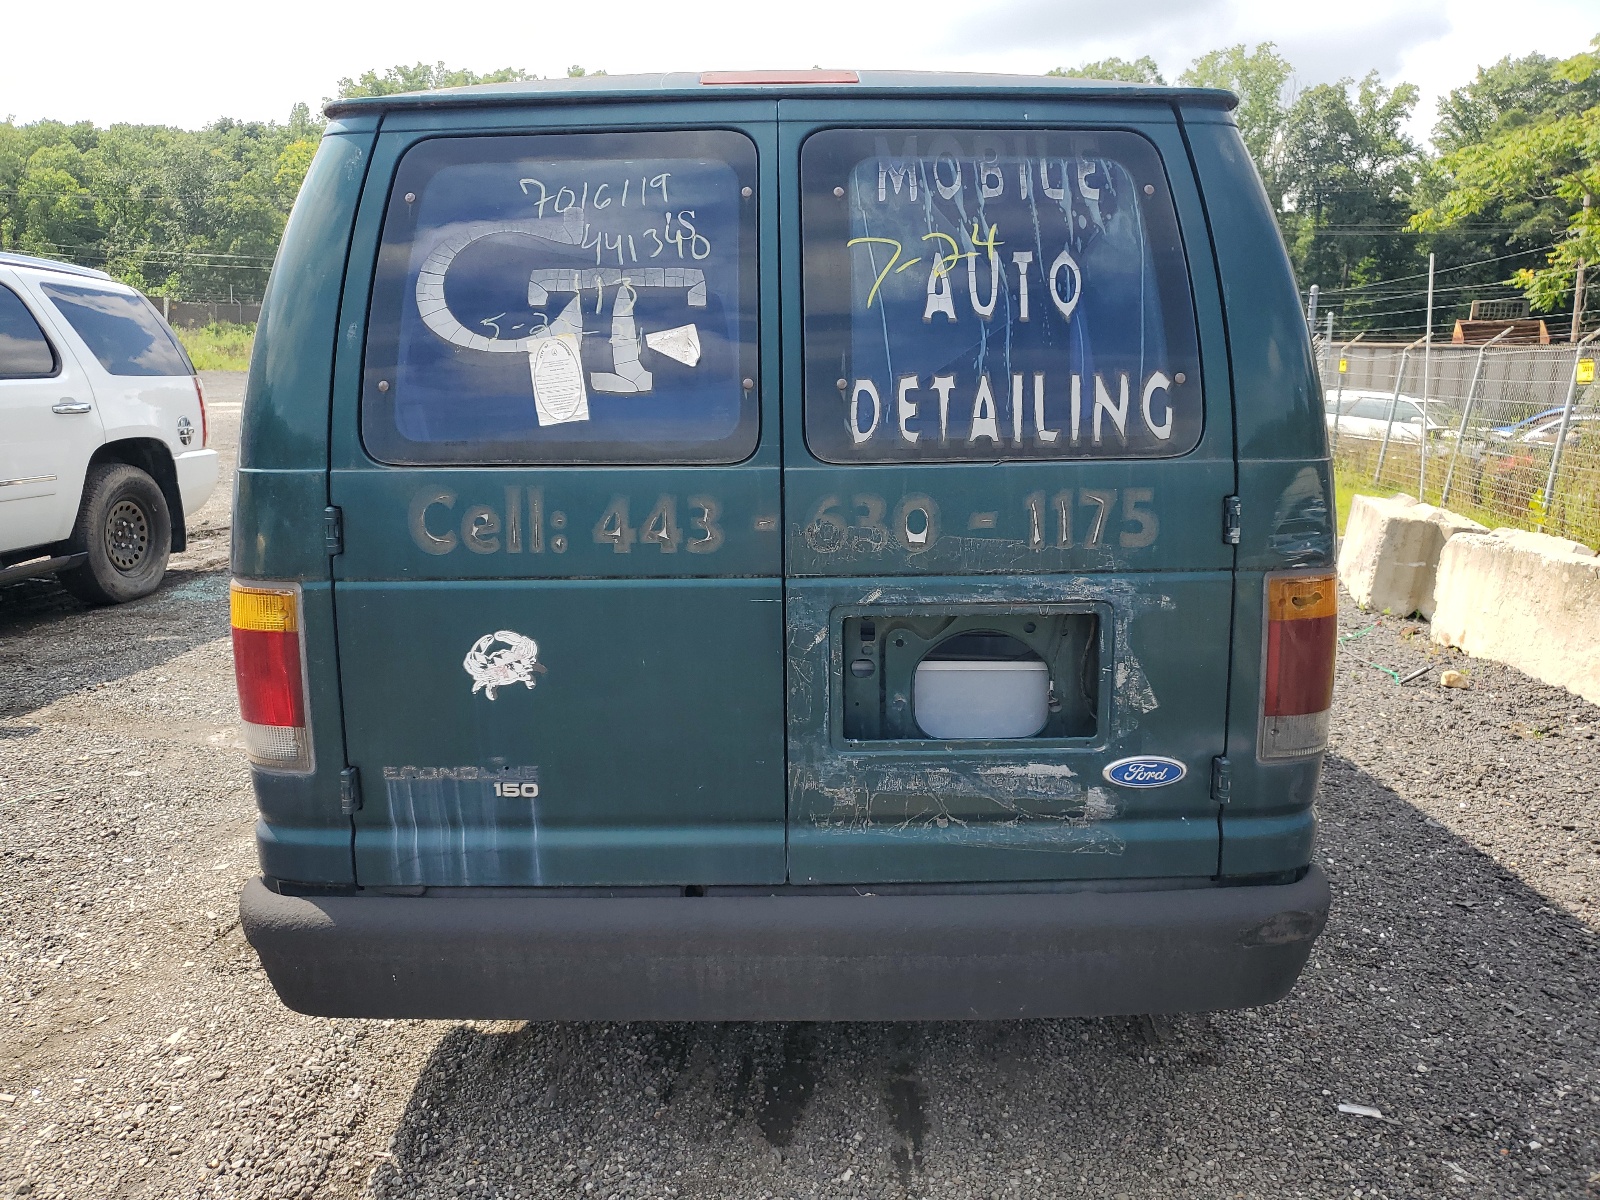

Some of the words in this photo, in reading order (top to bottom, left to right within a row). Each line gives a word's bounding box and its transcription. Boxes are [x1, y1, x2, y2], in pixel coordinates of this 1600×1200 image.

[876, 138, 1100, 201] MOBILE
[847, 222, 1005, 309] 7-24
[922, 250, 1082, 322] AUTO
[851, 371, 1173, 444] DETAILING
[408, 484, 568, 555] Cell:
[592, 493, 724, 554] 443
[805, 492, 941, 552] 630
[1023, 487, 1160, 551] 1175
[493, 781, 539, 797] 150
[1123, 764, 1169, 785] Ford
